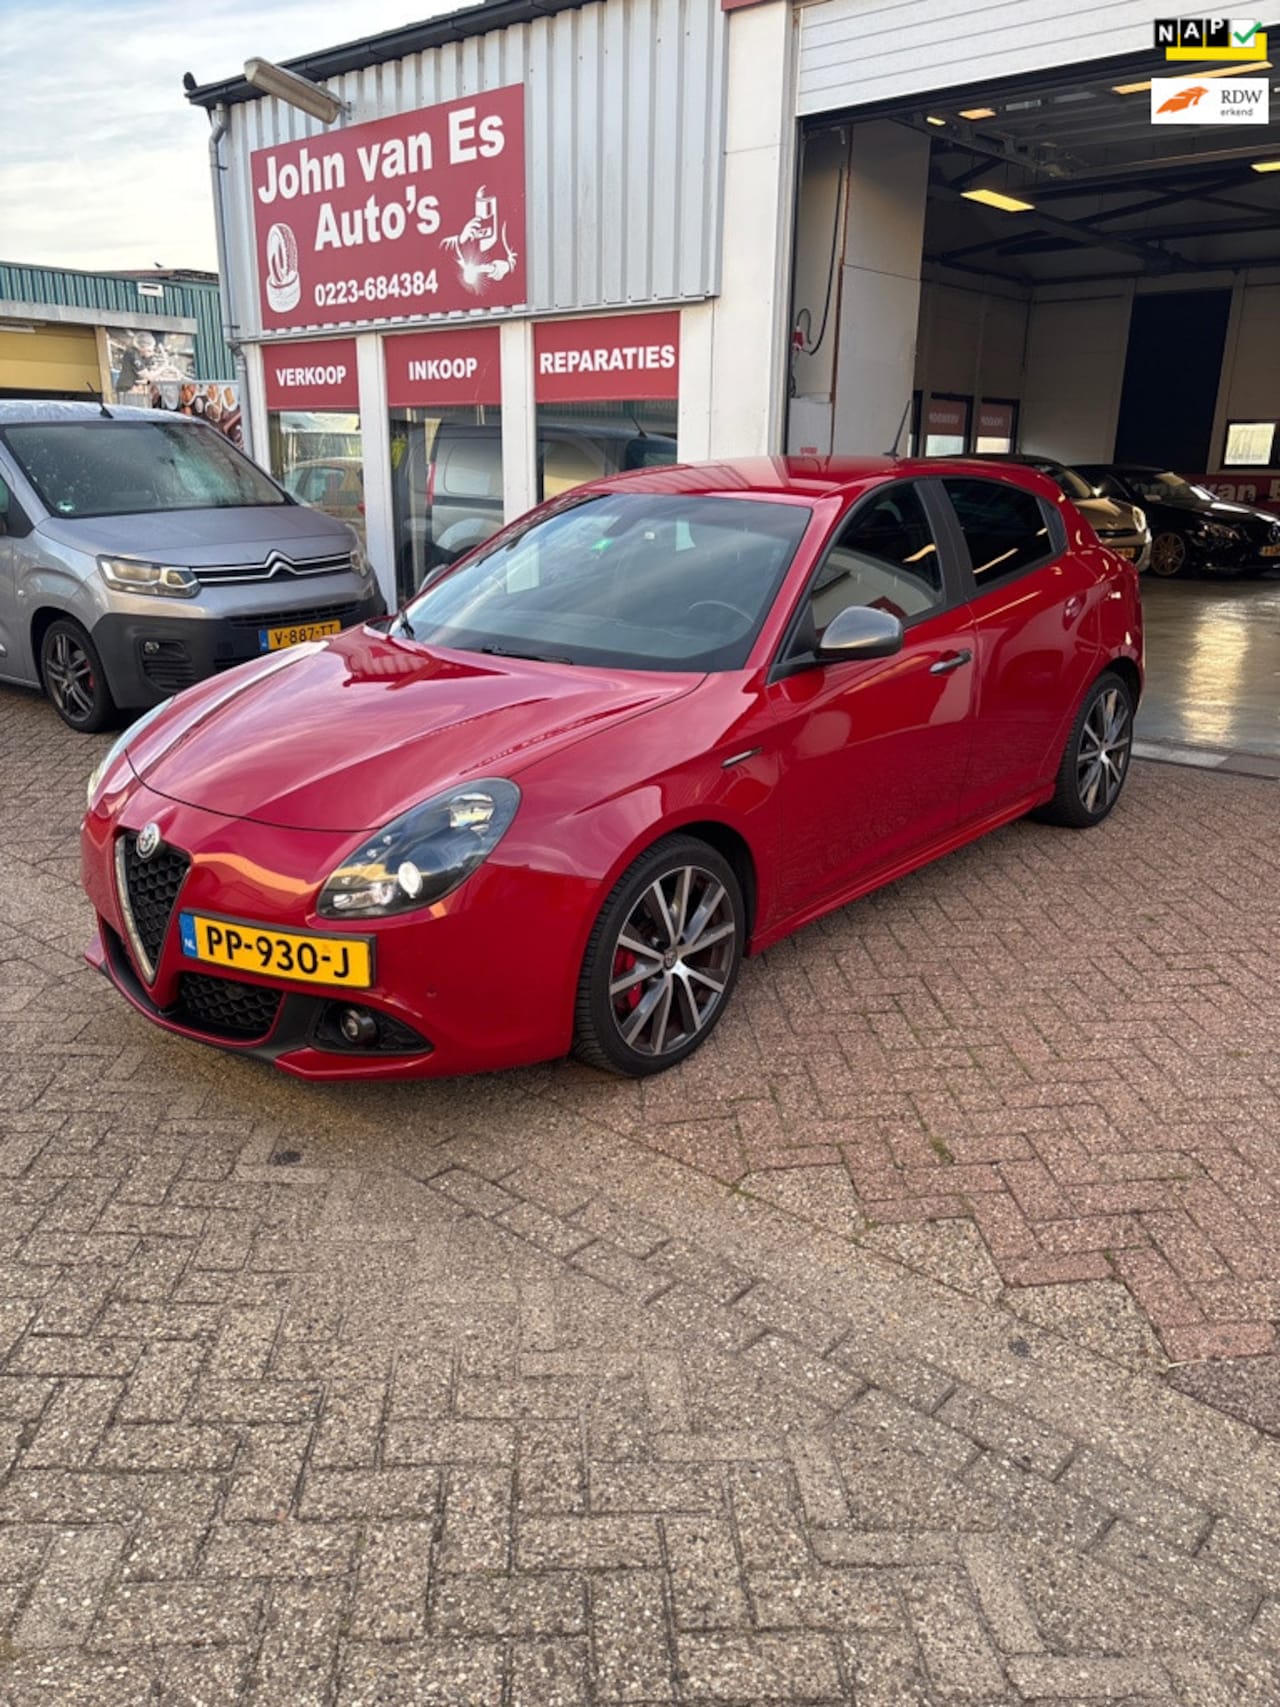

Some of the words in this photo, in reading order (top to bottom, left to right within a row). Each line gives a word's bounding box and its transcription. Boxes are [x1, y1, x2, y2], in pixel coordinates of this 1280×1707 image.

[257, 148, 346, 204] John
[357, 131, 433, 182] van
[448, 106, 505, 165] Es
[314, 185, 441, 251] Auto's
[314, 268, 438, 307] 0223-684384
[276, 365, 347, 387] VERKOOP
[408, 357, 478, 381] INKOOP
[539, 344, 676, 374] REPARATIES
[184, 938, 196, 950] NL
[206, 925, 350, 978] PP-930-J
